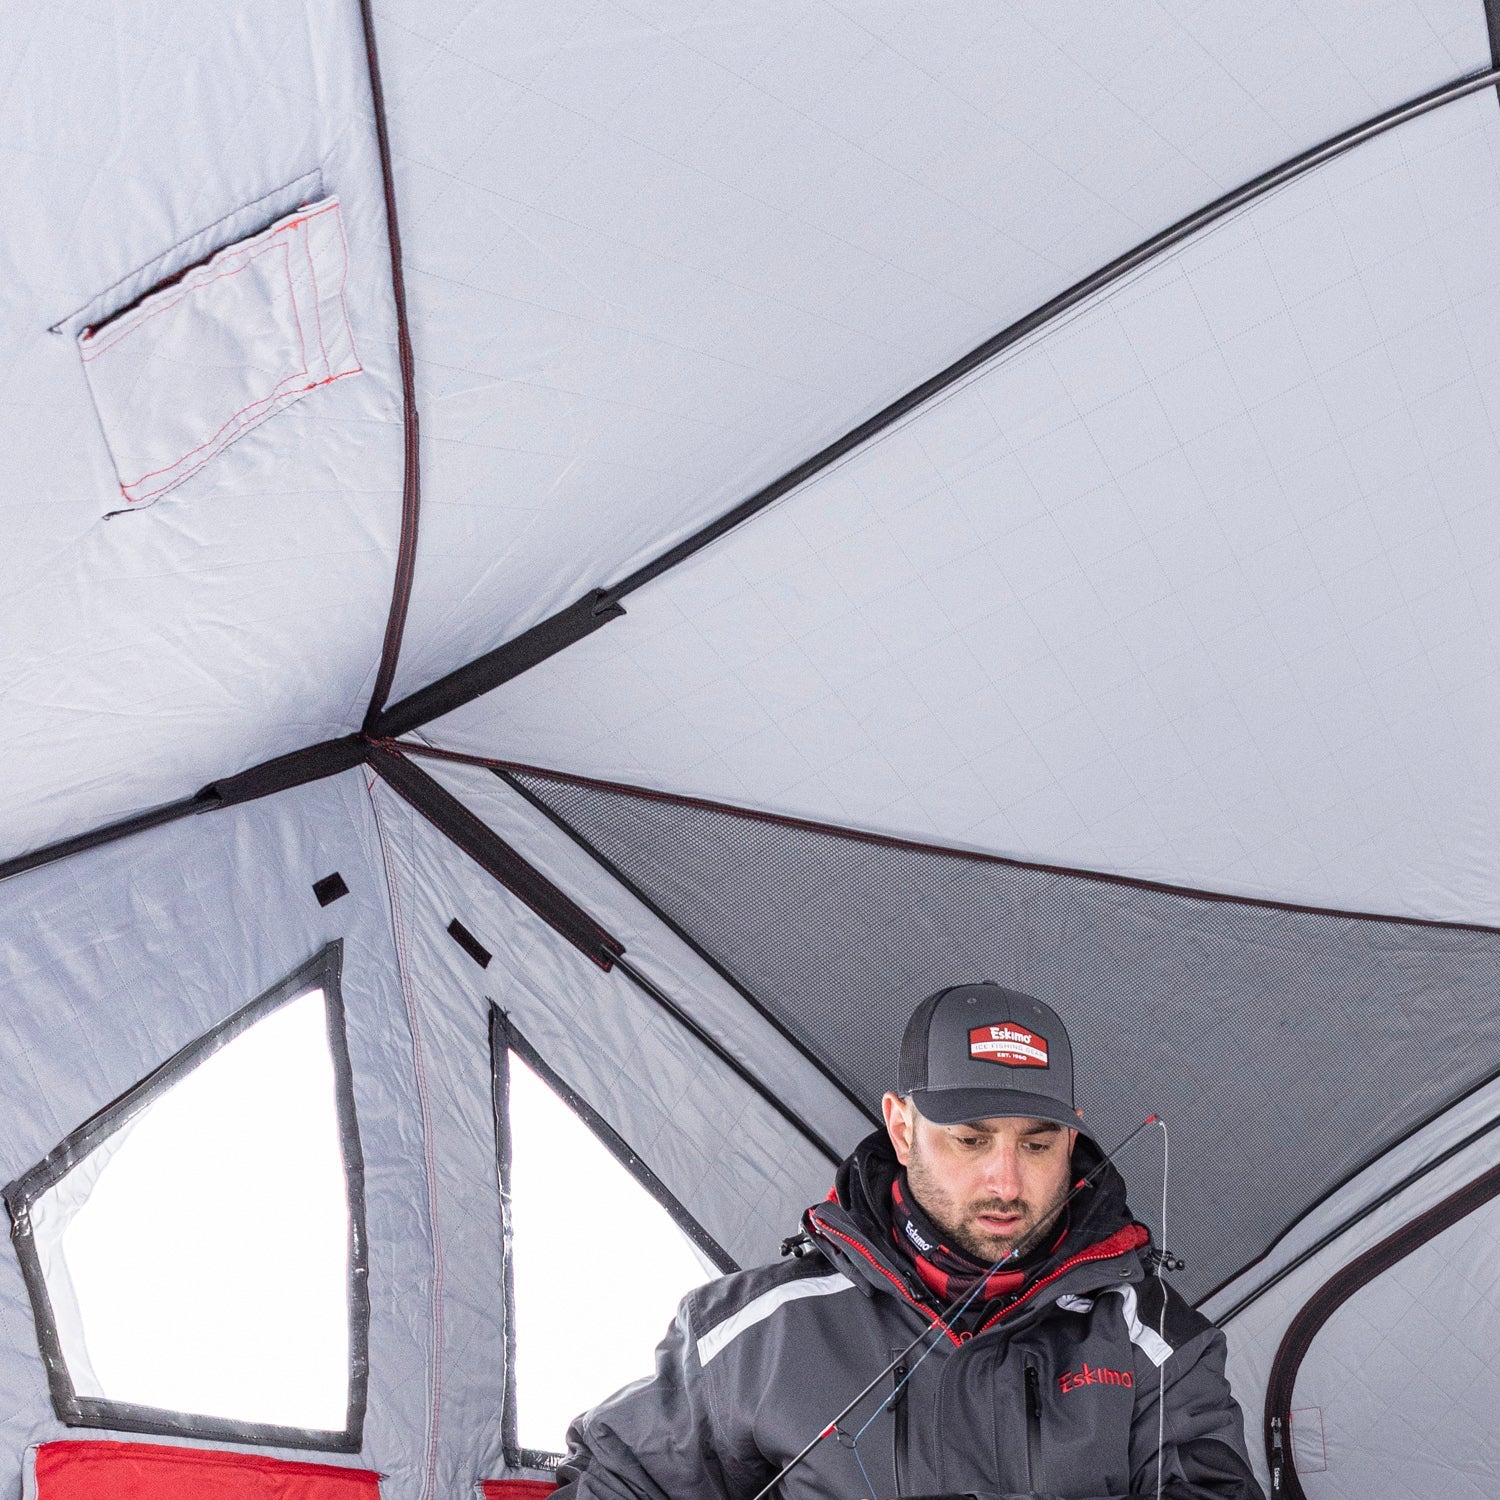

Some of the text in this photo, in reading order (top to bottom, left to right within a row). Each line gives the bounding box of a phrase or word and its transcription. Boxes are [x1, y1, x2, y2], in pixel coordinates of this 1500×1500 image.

[989, 1027, 1031, 1044] Eskimo
[905, 1220, 931, 1250] Eskimo
[1058, 1362, 1133, 1394] Eskimo
